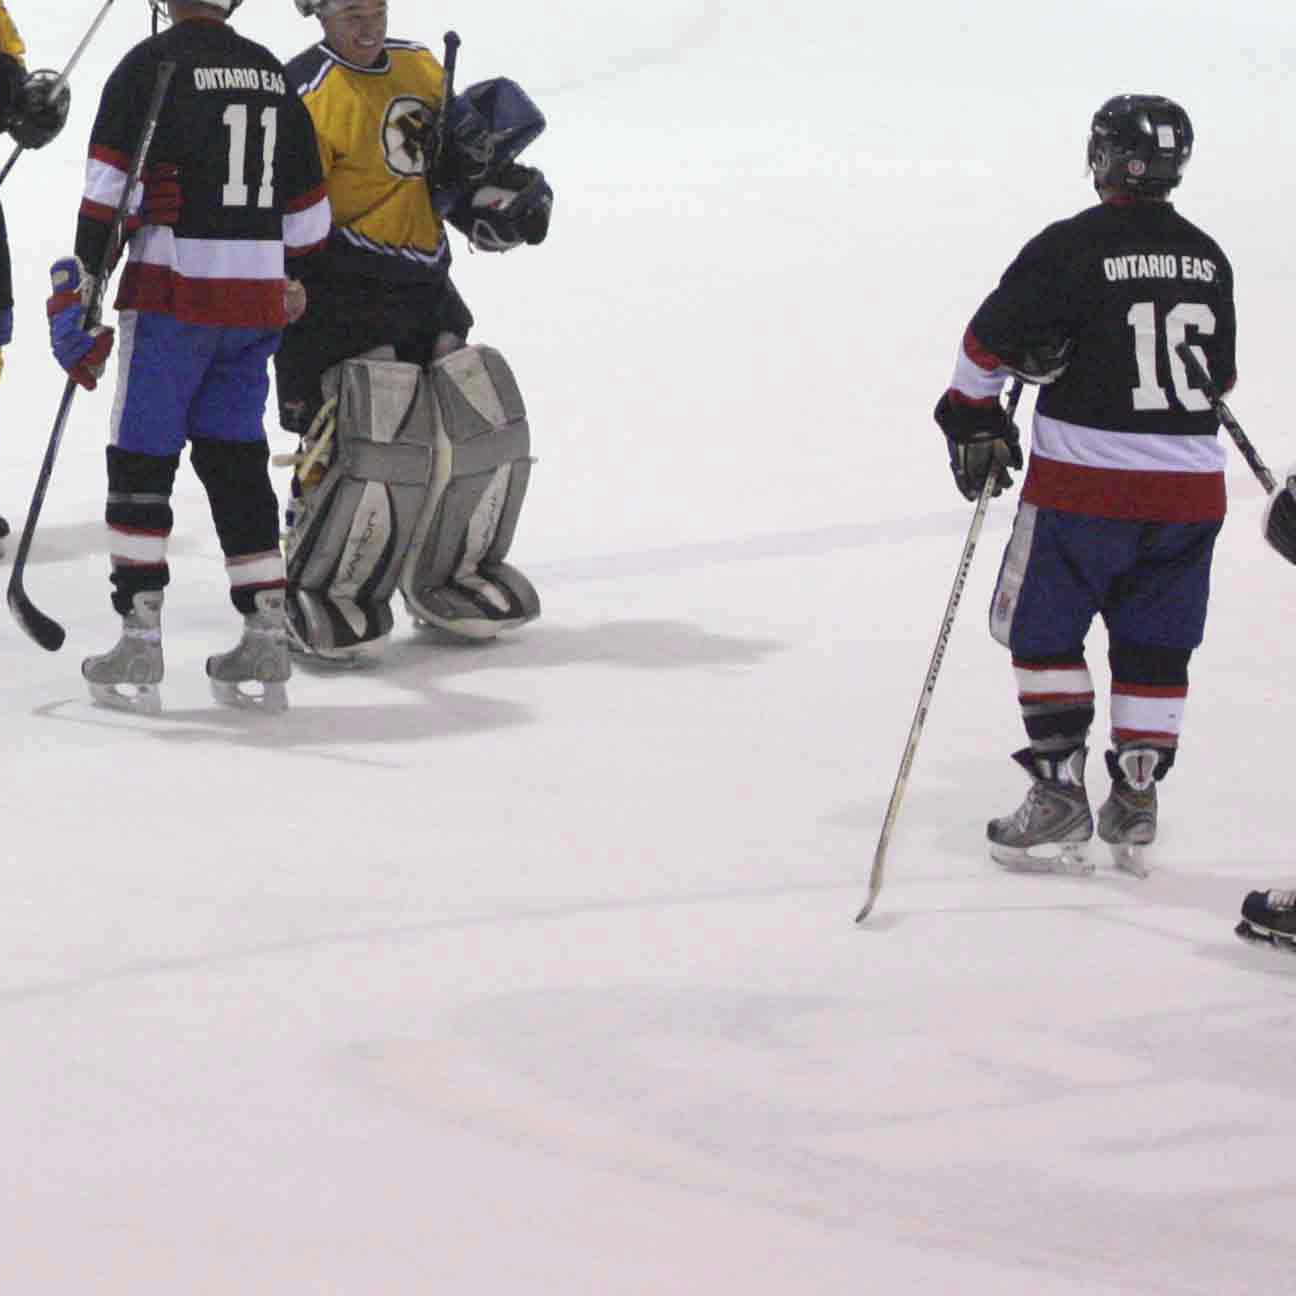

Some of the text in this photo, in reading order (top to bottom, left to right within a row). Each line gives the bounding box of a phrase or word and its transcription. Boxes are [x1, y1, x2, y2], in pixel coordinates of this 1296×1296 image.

[193, 67, 260, 91] ONTARIO
[222, 104, 278, 208] 11
[1104, 254, 1177, 282] ONTARIO
[1127, 301, 1216, 412] 16
